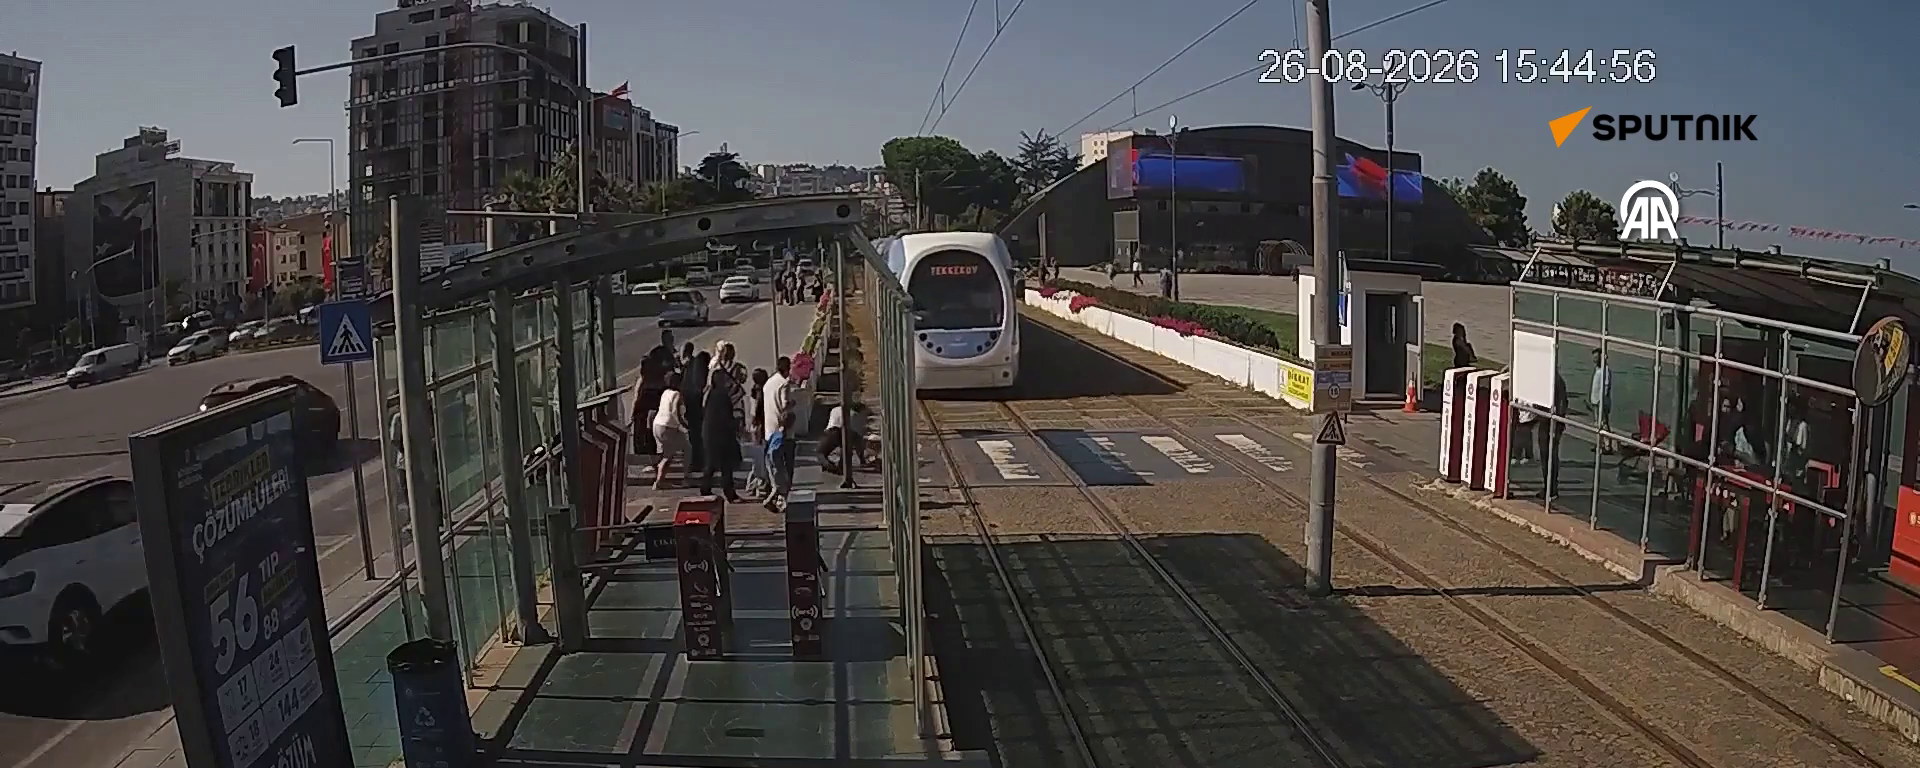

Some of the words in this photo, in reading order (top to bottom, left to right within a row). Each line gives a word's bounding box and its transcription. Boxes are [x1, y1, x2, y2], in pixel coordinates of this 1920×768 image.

[210, 572, 259, 675] 56
[263, 607, 280, 640] 88
[237, 674, 248, 696] 17
[277, 687, 300, 722] 144
